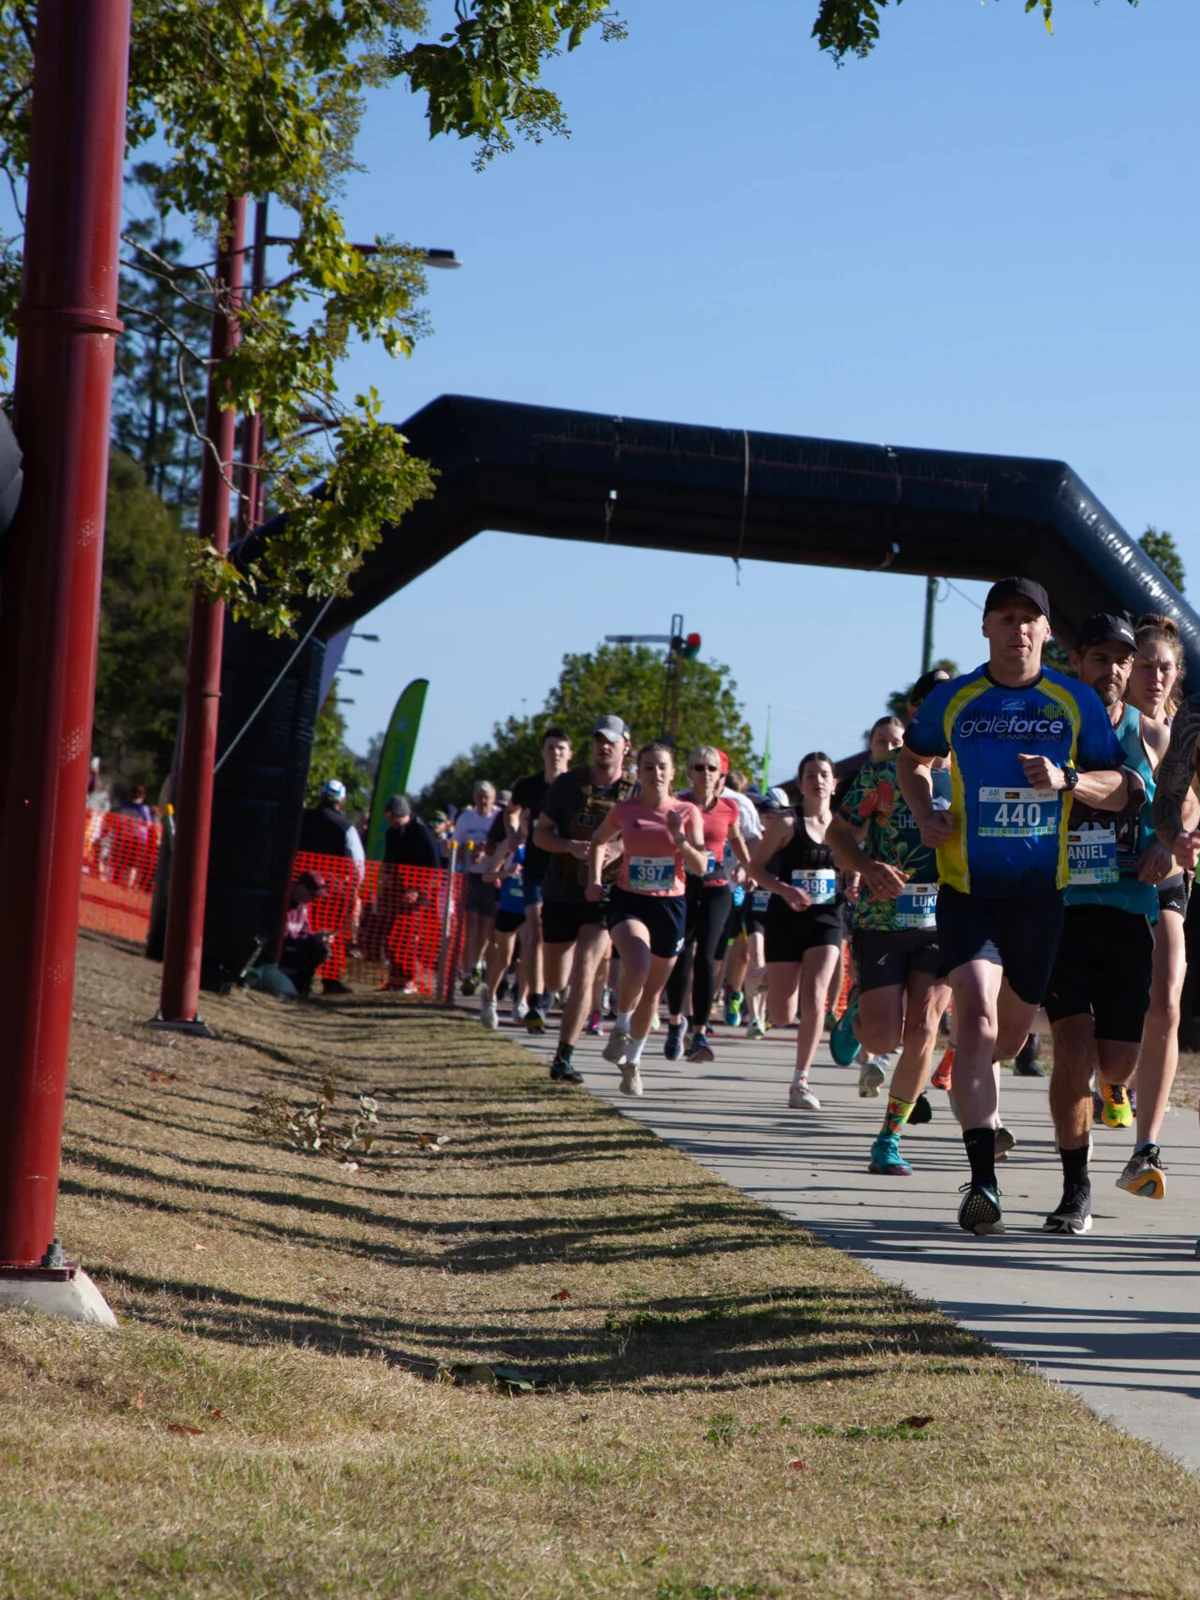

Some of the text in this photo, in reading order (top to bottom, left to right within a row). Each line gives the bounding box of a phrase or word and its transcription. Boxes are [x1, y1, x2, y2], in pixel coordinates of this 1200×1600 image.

[959, 716, 1064, 738] galeforce
[994, 803, 1042, 827] 440
[1068, 845, 1107, 860] ANIEL
[637, 867, 665, 881] 397
[802, 880, 828, 894] 398
